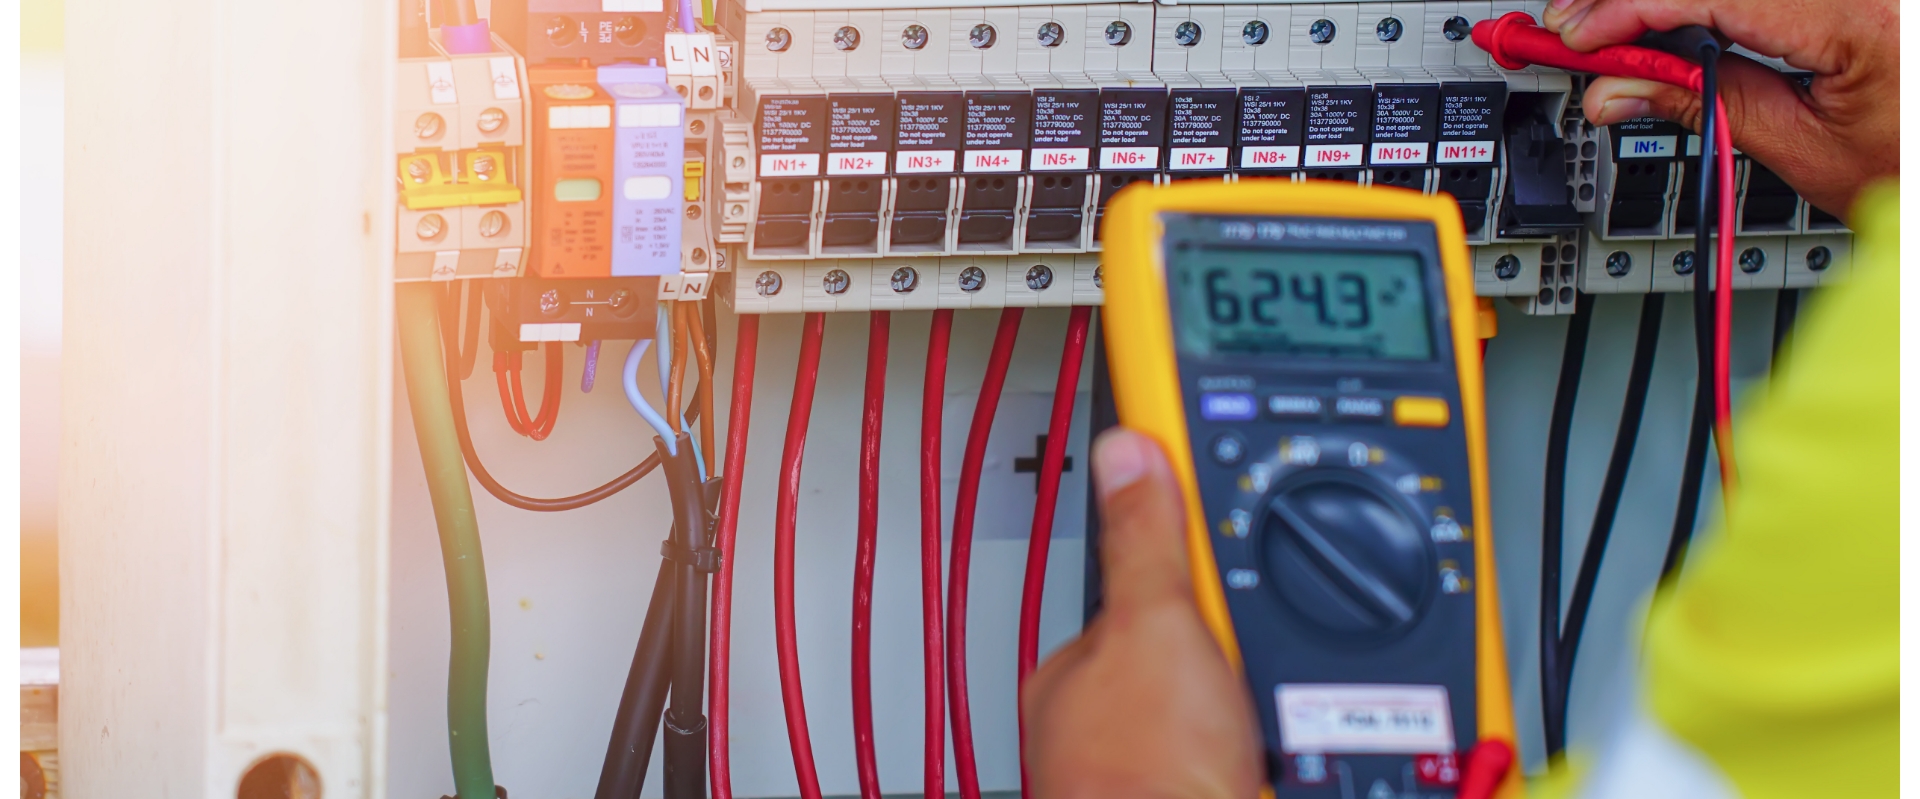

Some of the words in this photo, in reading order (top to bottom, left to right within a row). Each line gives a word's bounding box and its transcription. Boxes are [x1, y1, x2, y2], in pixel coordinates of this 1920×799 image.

[600, 22, 612, 32] PE
[670, 46, 683, 61] L
[693, 46, 710, 62] N
[1445, 146, 1486, 158] IN11+
[1634, 141, 1664, 153] IN1-
[1113, 152, 1146, 163] IN6+
[1182, 153, 1215, 164] IN7+
[1253, 152, 1286, 163] IN8+
[1317, 150, 1350, 162] IN9+
[1378, 148, 1420, 159] IN10+
[773, 160, 806, 170] IN1+
[840, 158, 873, 169] IN2+
[908, 157, 942, 168] IN3+
[976, 156, 1009, 167] IN4+
[1043, 154, 1076, 165] IN5+
[663, 282, 675, 292] L
[684, 283, 701, 293] N
[587, 290, 594, 298] N
[586, 308, 593, 316] N
